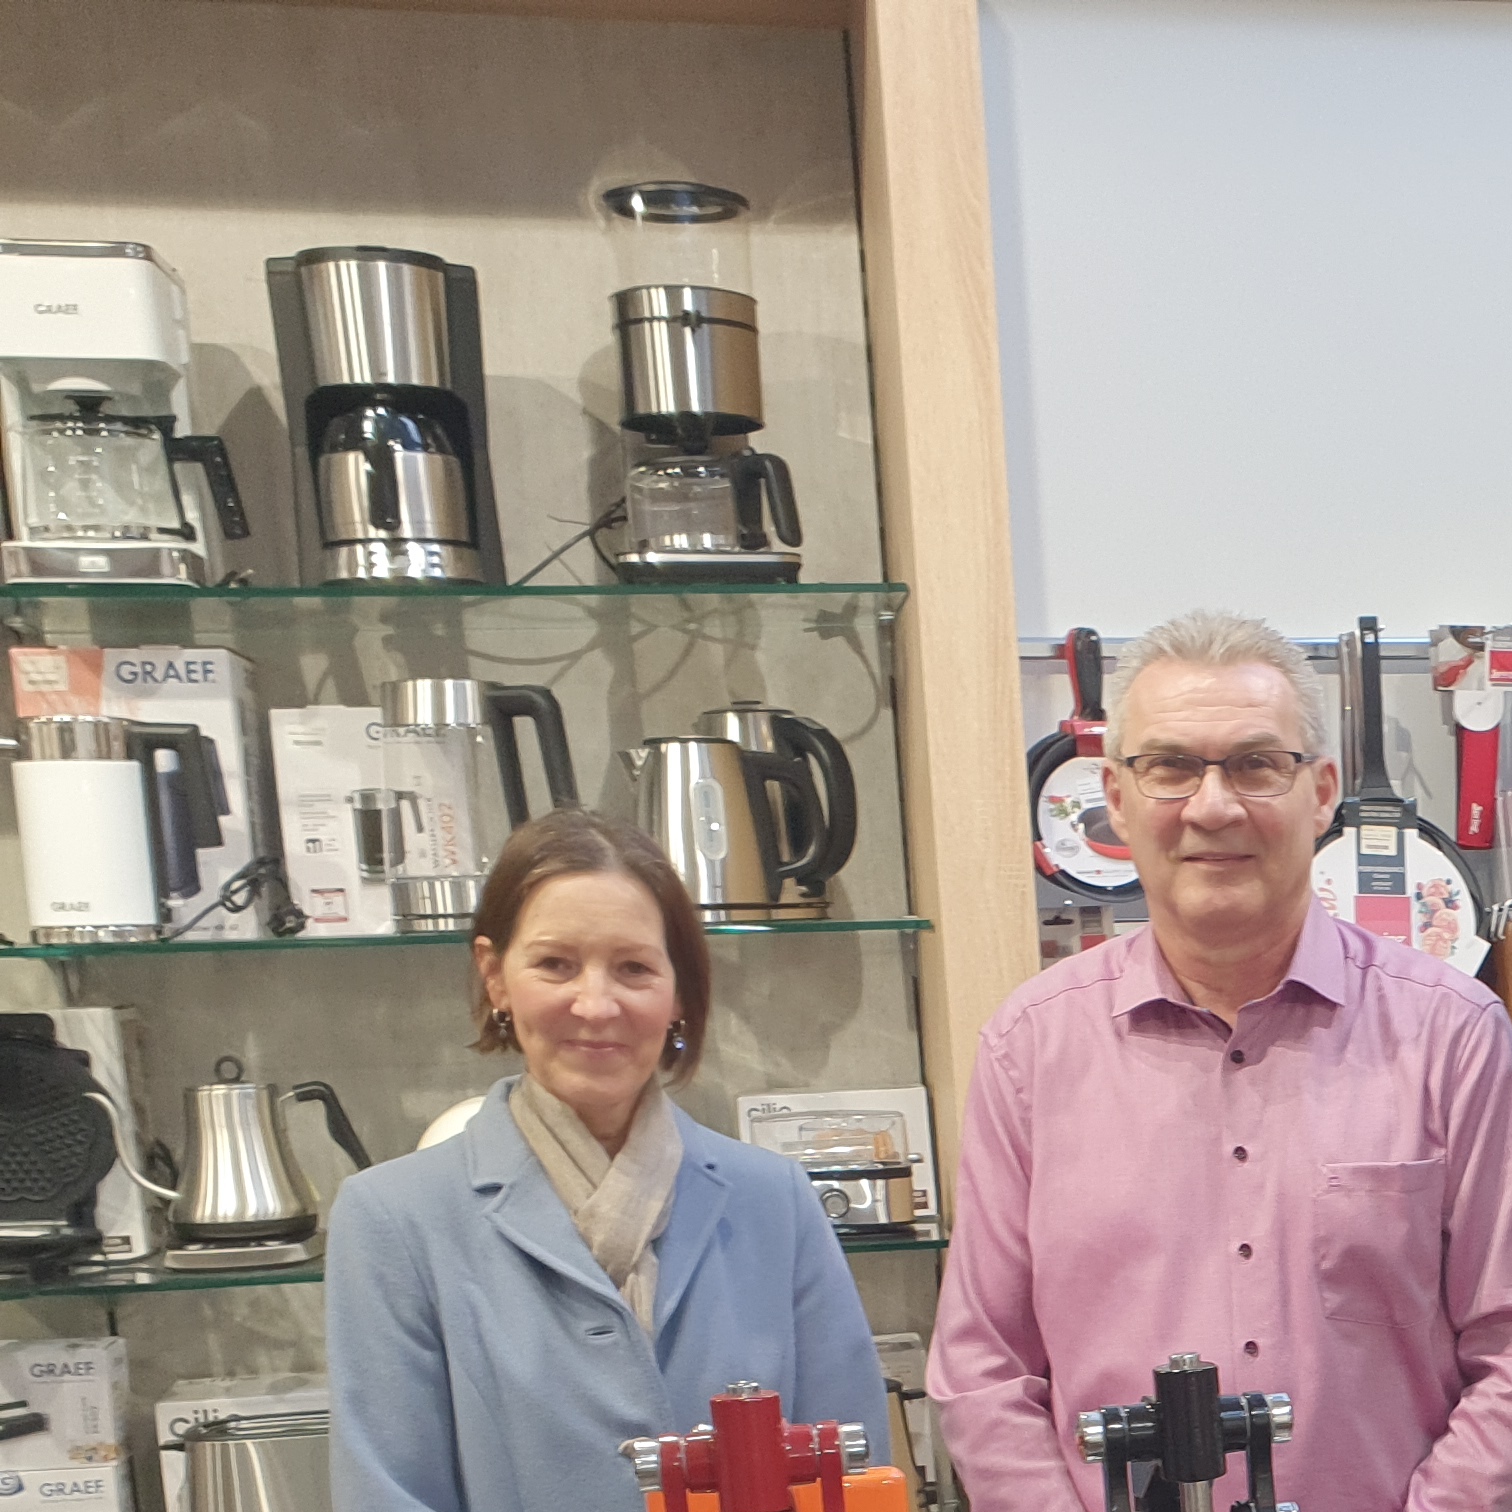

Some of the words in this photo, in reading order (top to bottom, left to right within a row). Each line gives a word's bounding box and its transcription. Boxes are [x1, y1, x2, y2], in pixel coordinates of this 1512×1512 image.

[116, 660, 215, 684] GRAEF
[29, 1361, 96, 1378] GRAEF
[39, 1479, 105, 1498] GRAEF
